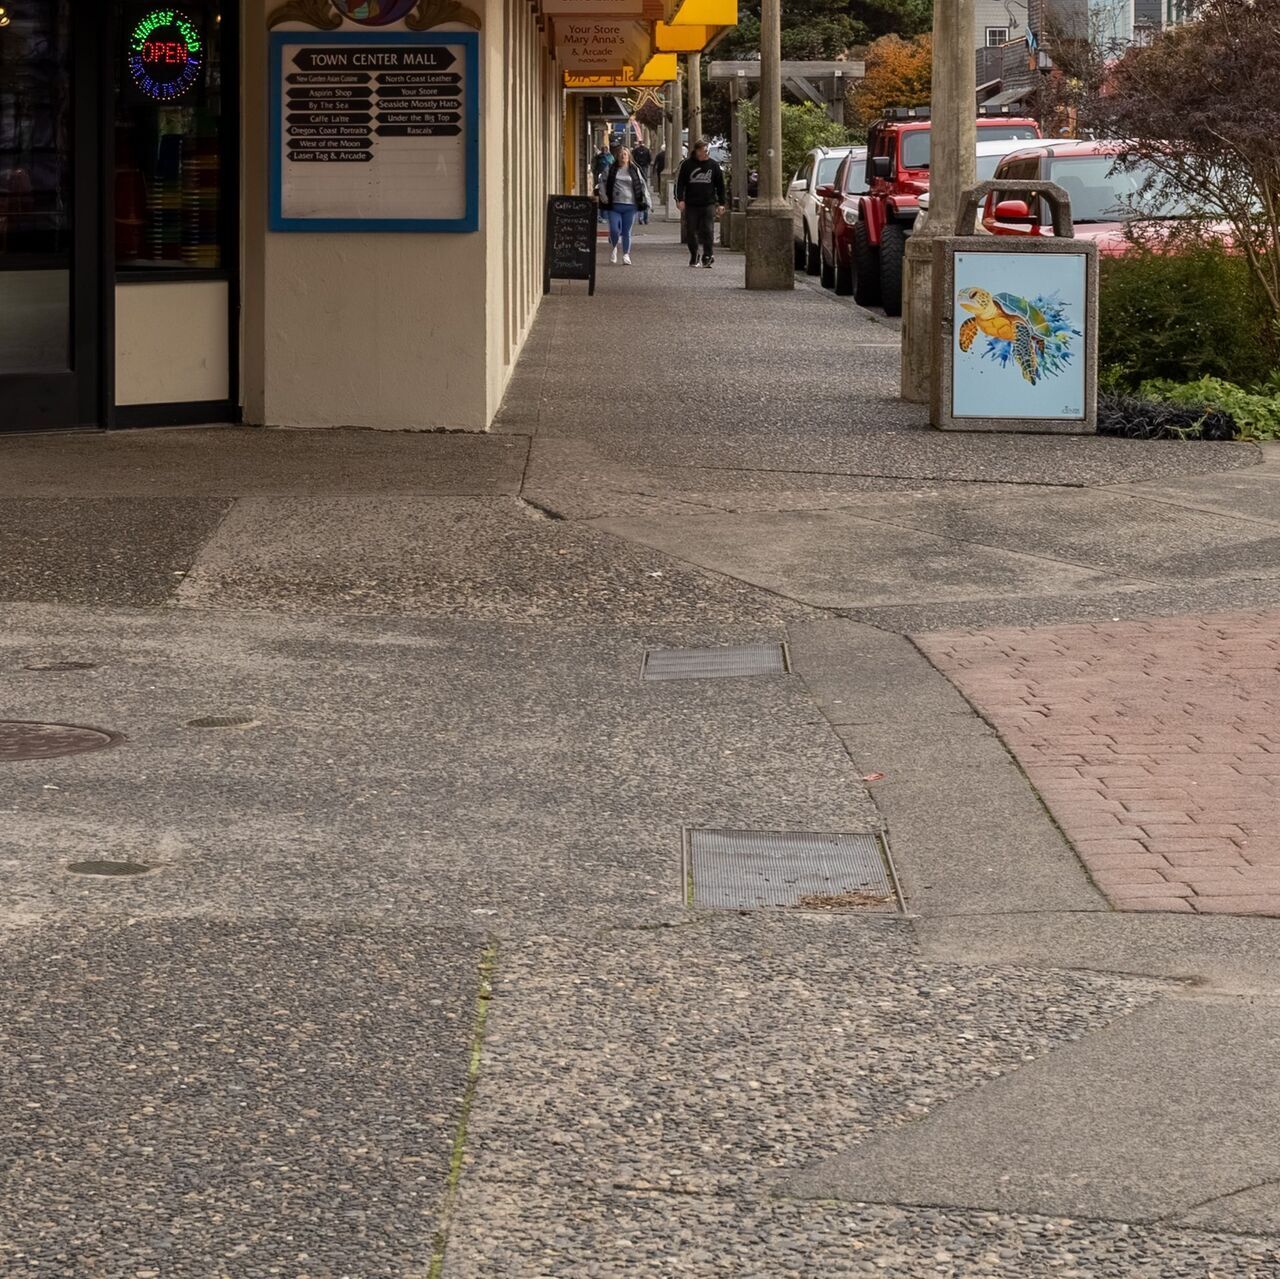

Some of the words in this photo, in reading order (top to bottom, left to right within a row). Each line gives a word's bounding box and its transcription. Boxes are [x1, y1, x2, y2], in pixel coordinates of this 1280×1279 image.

[569, 25, 591, 34] Your
[594, 25, 620, 34] Store
[564, 35, 588, 45] Mary
[591, 34, 624, 44] Anna's
[142, 42, 188, 63] OPEN
[583, 48, 613, 56] Arcade
[310, 54, 347, 66] TOWN
[352, 54, 398, 65] CENTER
[403, 54, 437, 65] MALL
[309, 102, 318, 110] By
[380, 100, 408, 108] Seaside
[410, 100, 438, 108] Mostly
[440, 100, 458, 108] Hats
[388, 114, 408, 122] Under
[438, 114, 450, 122] Top
[291, 127, 316, 135] Oregon
[315, 152, 328, 160] Tag
